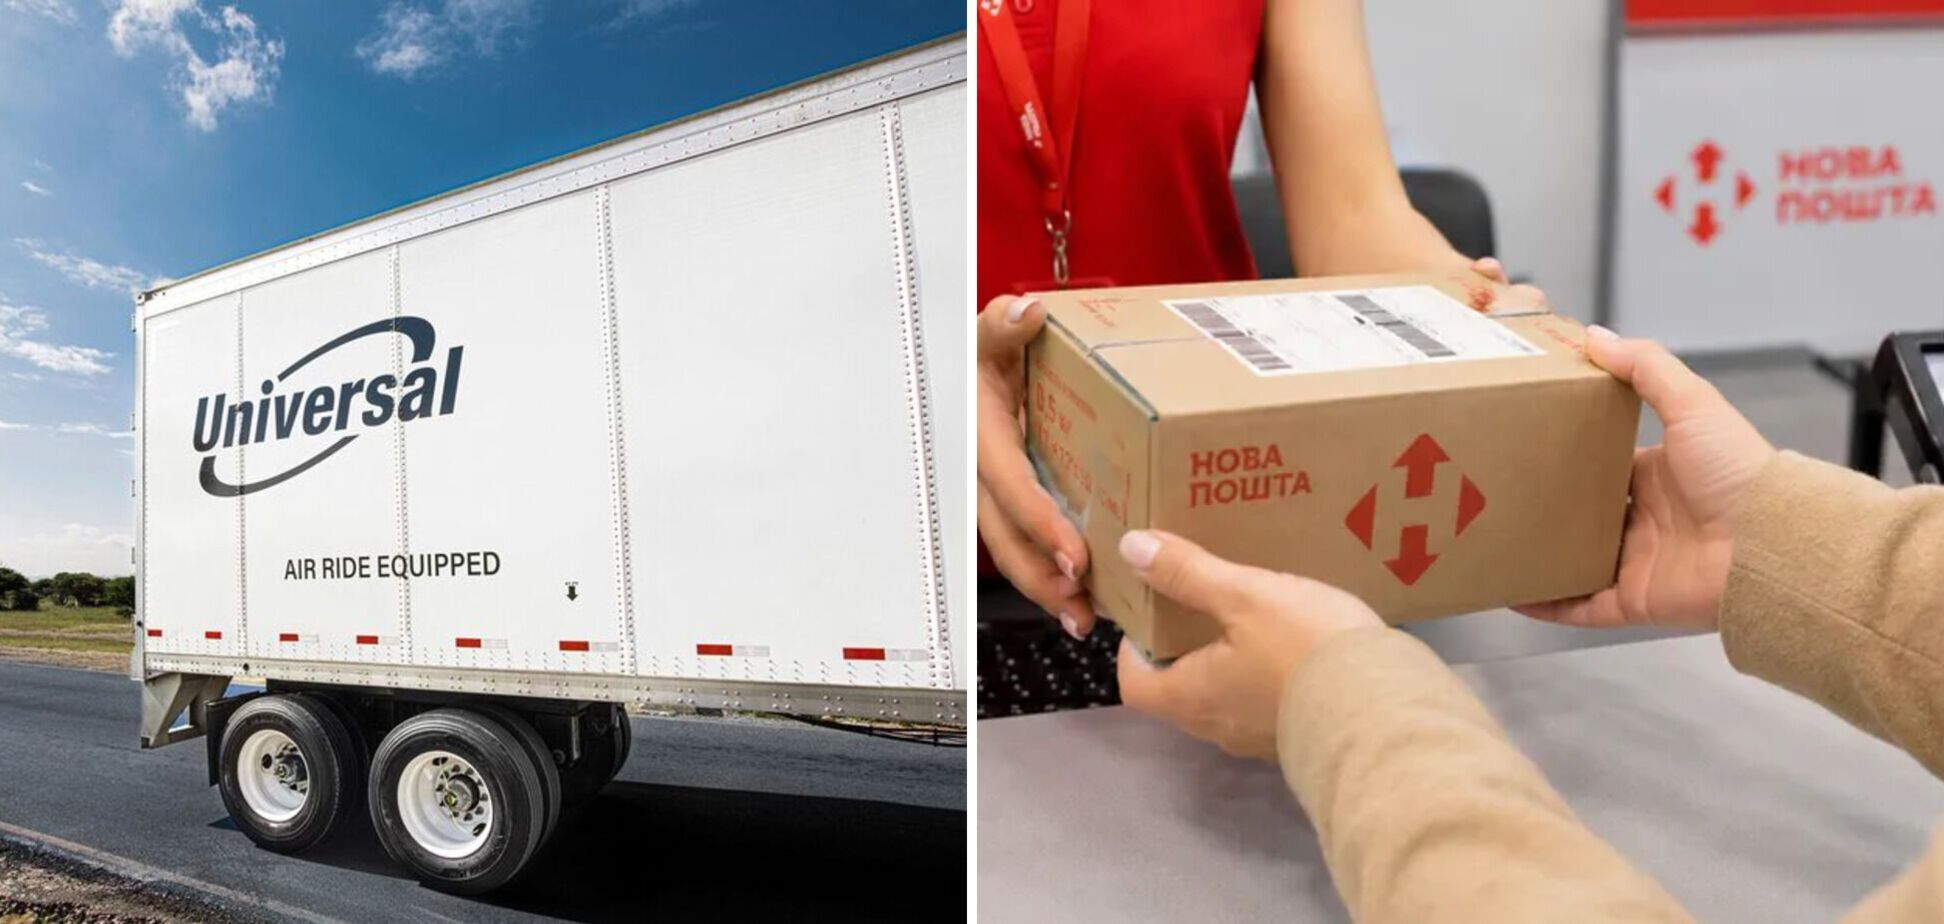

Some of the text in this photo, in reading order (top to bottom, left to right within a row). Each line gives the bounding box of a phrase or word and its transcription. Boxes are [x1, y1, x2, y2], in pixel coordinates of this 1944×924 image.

[1777, 144, 1902, 182] НОВА
[1775, 181, 1937, 224] ПОШТА
[193, 345, 464, 452] Universal
[1190, 444, 1284, 477] НОВА
[1189, 470, 1312, 508] ПОШТА
[284, 551, 501, 580] AIR RIDE EQUIPPED
